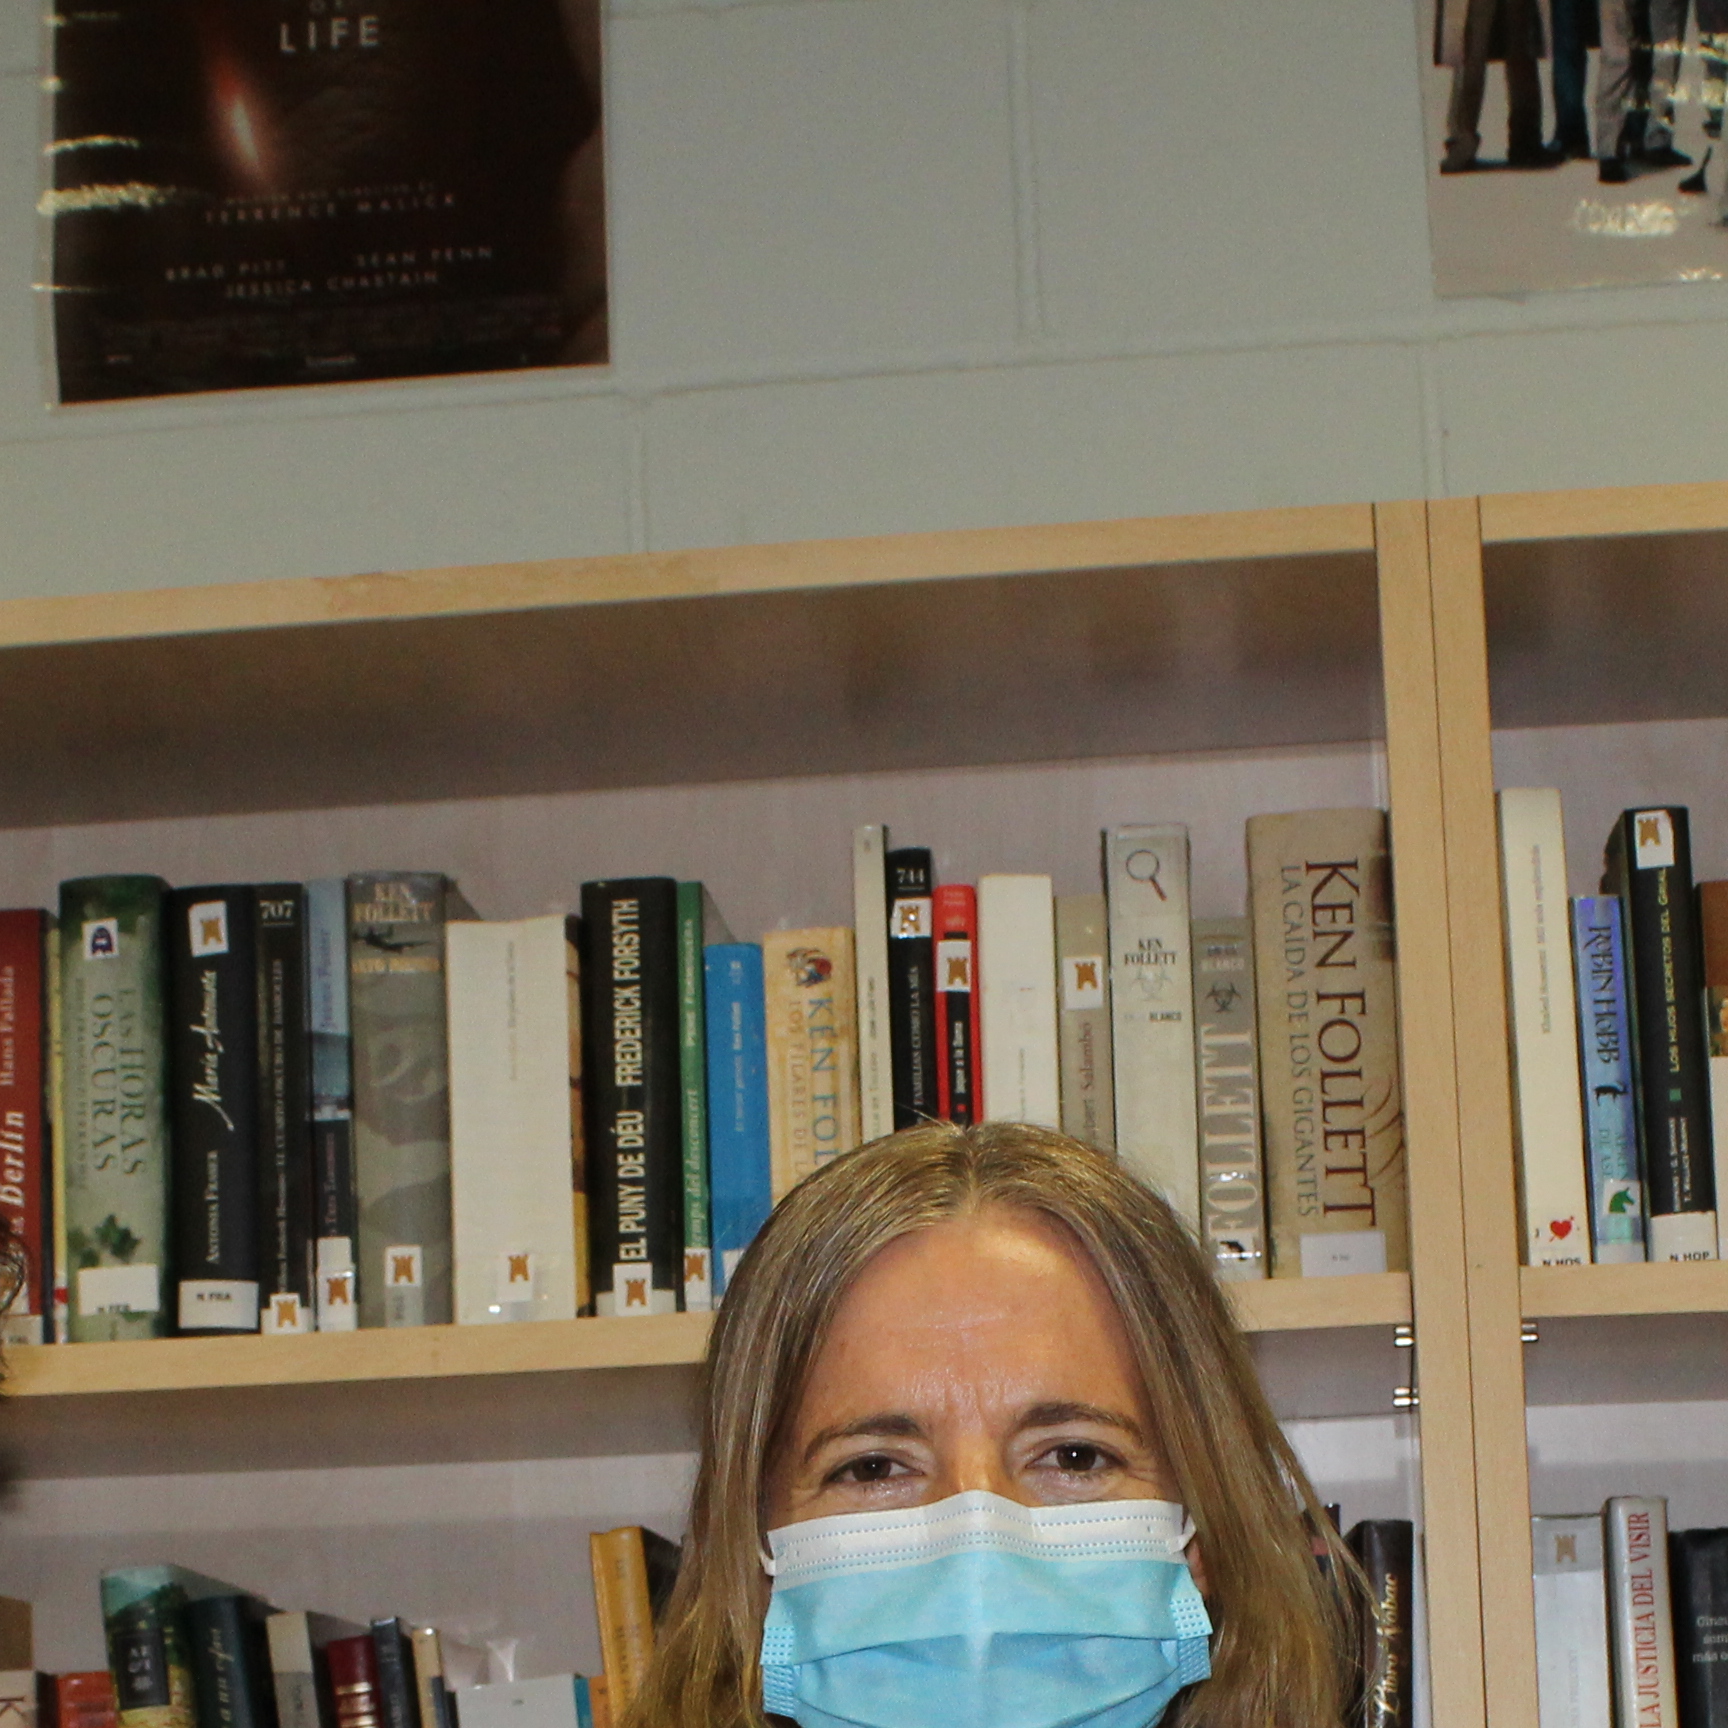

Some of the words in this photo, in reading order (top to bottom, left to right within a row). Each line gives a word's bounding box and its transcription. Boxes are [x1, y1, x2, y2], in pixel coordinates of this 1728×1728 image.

[280, 15, 381, 53] LIFE
[1280, 863, 1303, 896] LA
[1306, 858, 1361, 972] KEN
[611, 898, 641, 981] FORSYTH
[1124, 949, 1178, 966] FOLLETT
[1138, 939, 1164, 950] KEN
[1288, 990, 1309, 1026] DE
[614, 984, 644, 1087] FREDERICK
[807, 997, 835, 1074] KEN
[1289, 1032, 1311, 1078] LOS
[91, 994, 119, 1173] OSCURAS
[120, 1046, 147, 1174] HORAS
[609, 1110, 645, 1148] DÉU
[1316, 989, 1377, 1227] FOLLETT
[617, 1152, 646, 1178] DE
[1292, 1086, 1320, 1217] GIGANTES
[618, 1183, 648, 1234] PUNY
[619, 1237, 648, 1261] EL
[1628, 1510, 1650, 1563] VISIR
[1630, 1569, 1654, 1606] DEL
[1633, 1611, 1660, 1700] JUSTICIA
[1639, 1703, 1662, 1728] LA
